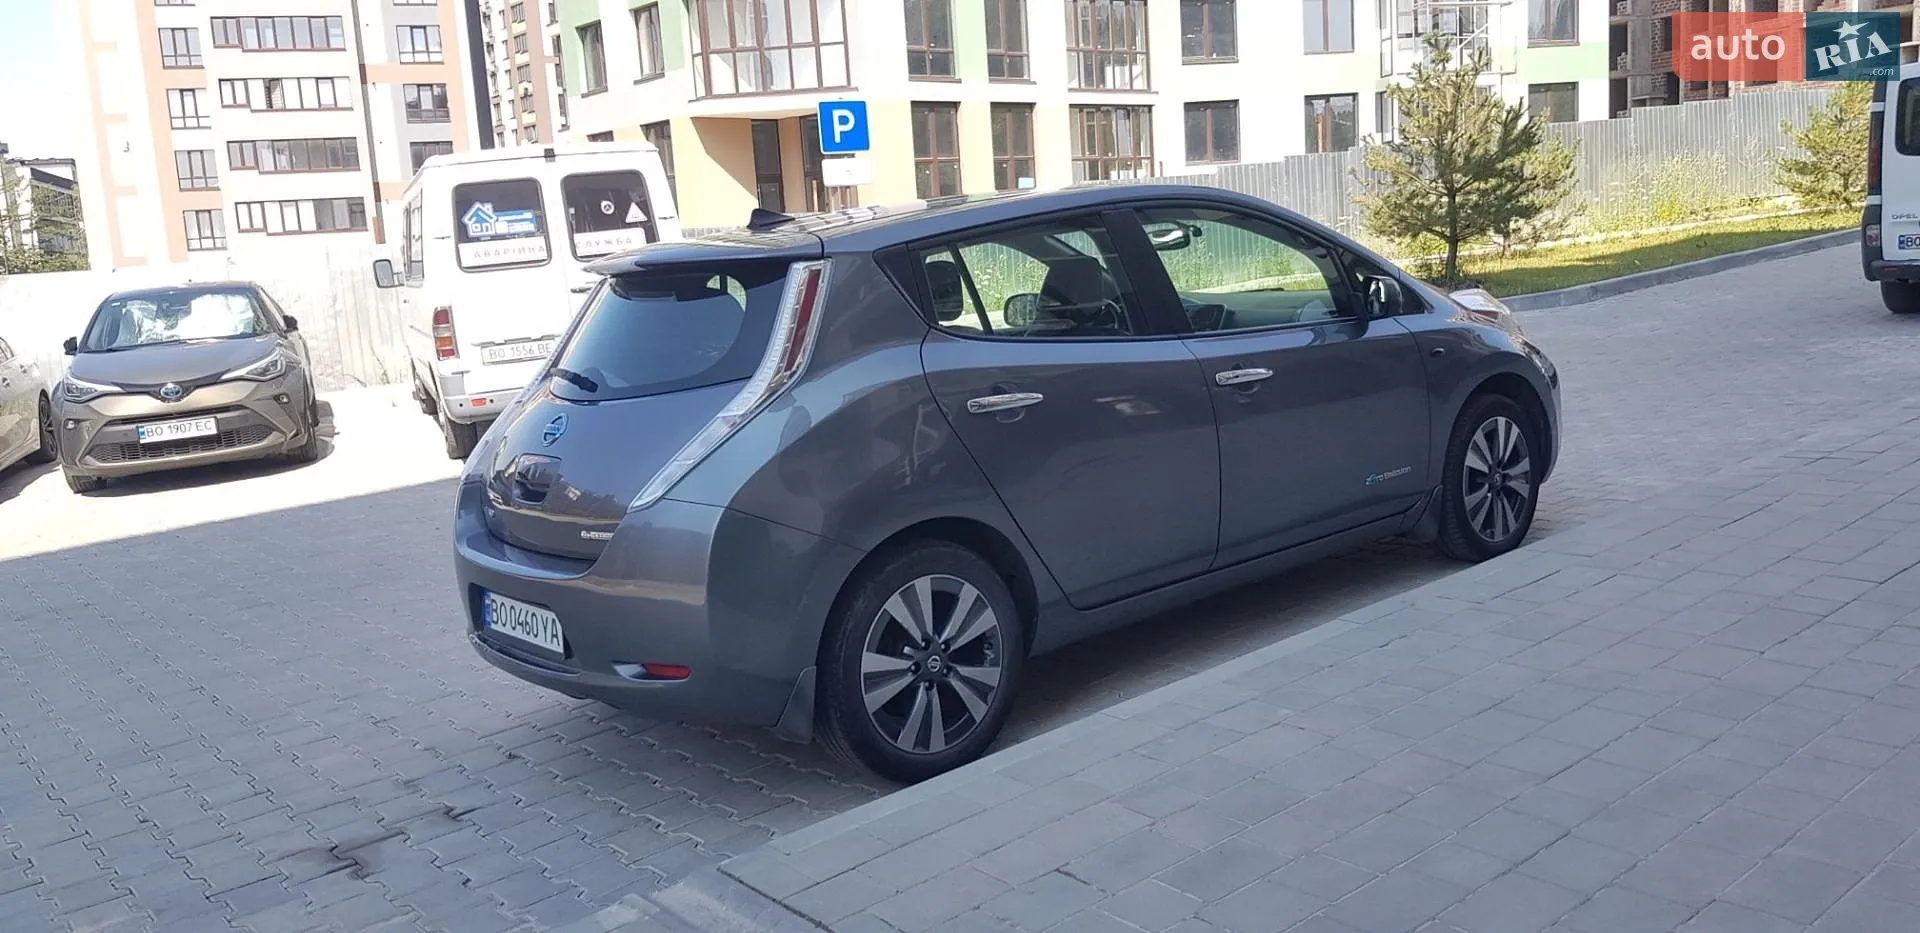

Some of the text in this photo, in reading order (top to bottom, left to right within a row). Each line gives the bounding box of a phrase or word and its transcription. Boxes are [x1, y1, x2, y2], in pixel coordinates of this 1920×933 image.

[832, 109, 856, 144] P
[1891, 212, 1919, 220] OPEL
[168, 422, 192, 434] 1907
